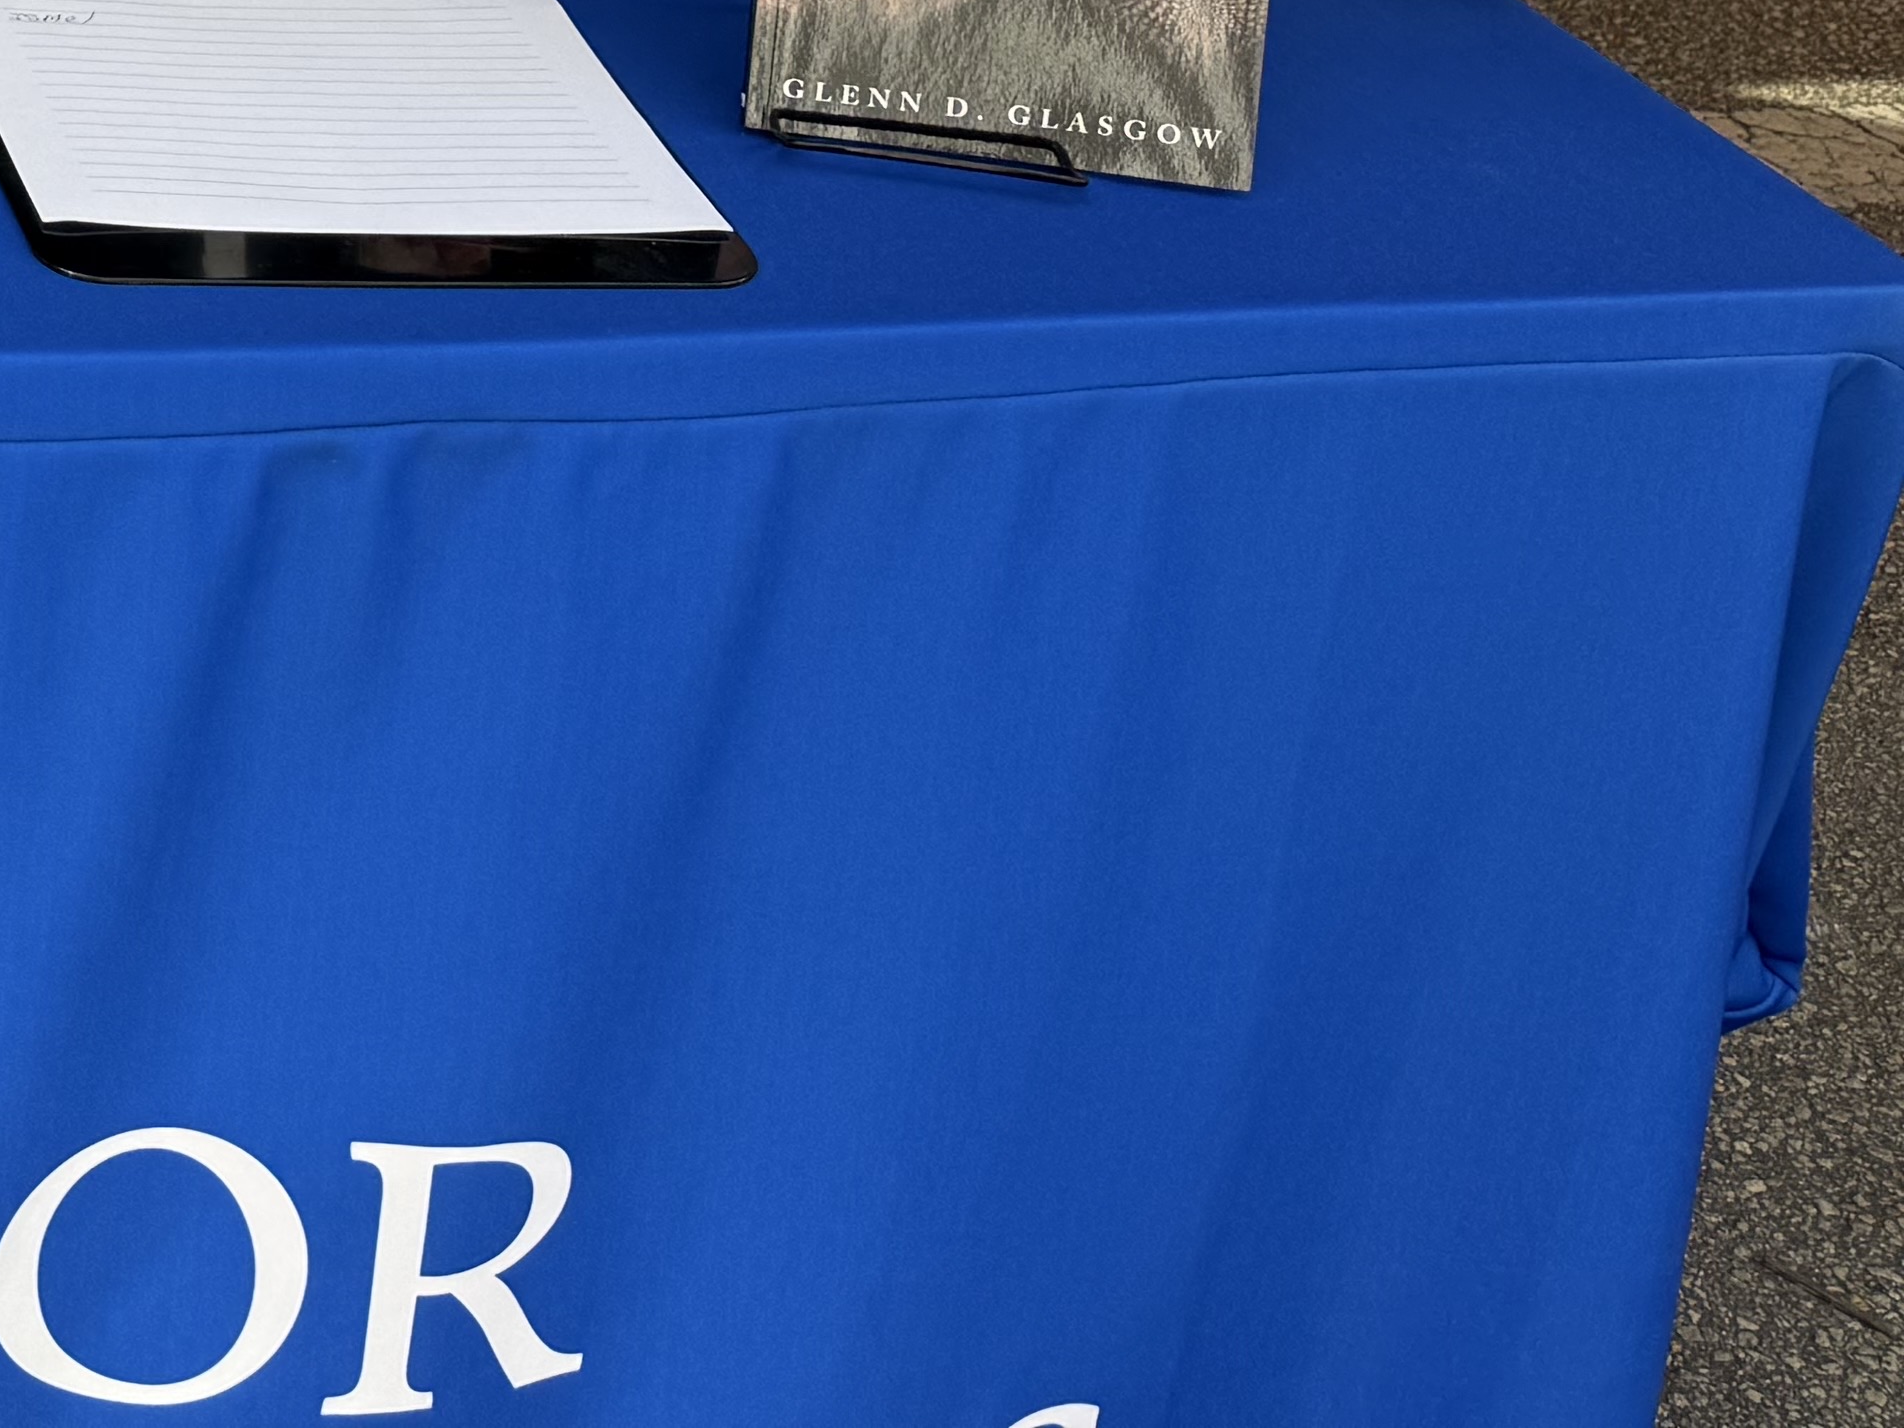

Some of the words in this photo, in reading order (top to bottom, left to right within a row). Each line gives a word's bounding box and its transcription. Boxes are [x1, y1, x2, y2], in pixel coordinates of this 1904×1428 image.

[782, 77, 924, 115] GLENN
[946, 95, 985, 125] D.
[1007, 103, 1224, 151] GLASGOW
